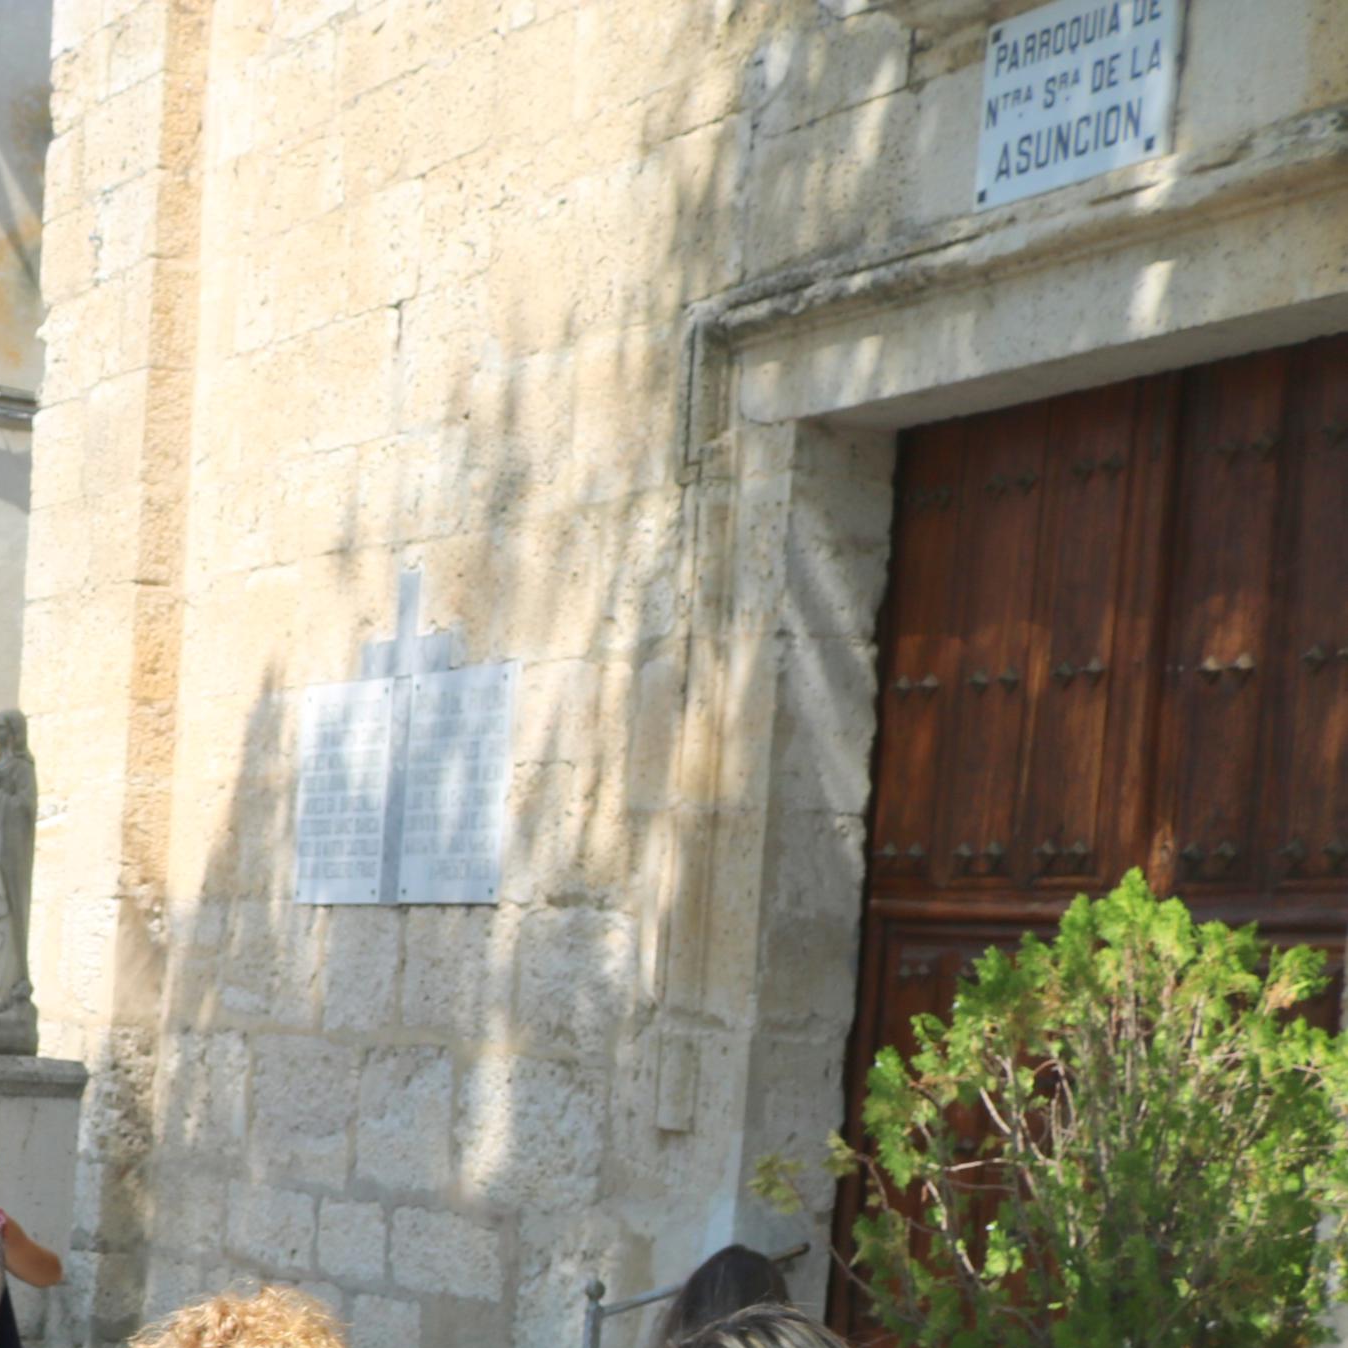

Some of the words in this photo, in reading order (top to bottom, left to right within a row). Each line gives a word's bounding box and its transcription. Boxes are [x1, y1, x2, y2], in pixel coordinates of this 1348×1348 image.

[993, 6, 1121, 79] PARROQUIA
[1090, 52, 1122, 95] DE
[1130, 38, 1162, 81] LA
[994, 98, 1143, 183] ASUNCION
